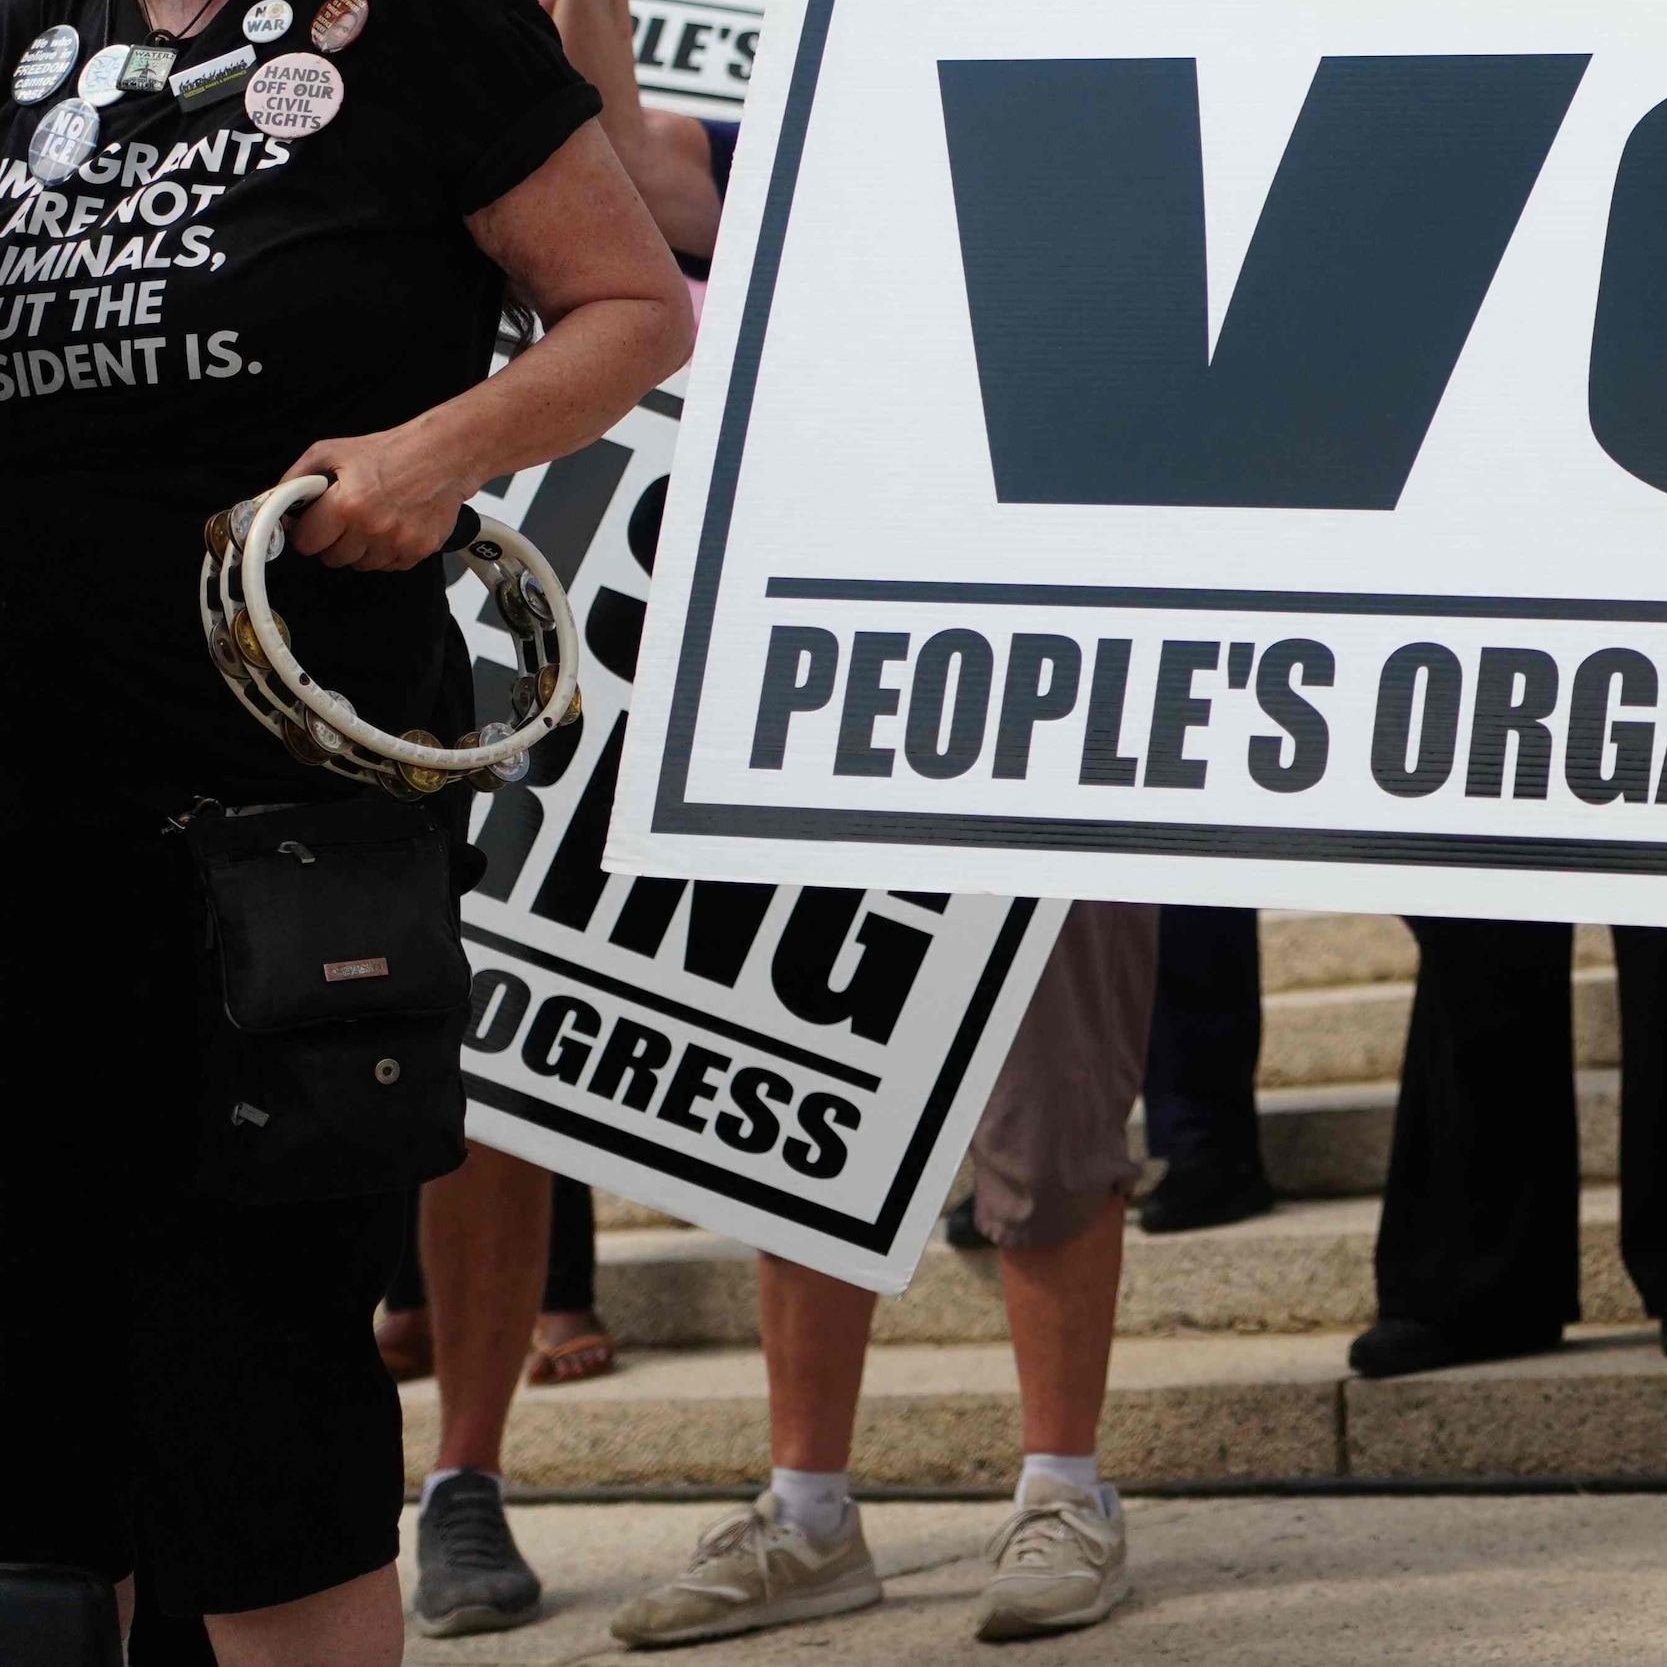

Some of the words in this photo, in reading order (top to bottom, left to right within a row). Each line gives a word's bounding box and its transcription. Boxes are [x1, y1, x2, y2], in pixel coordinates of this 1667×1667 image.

[247, 18, 285, 33] WAR
[30, 38, 49, 50] We
[50, 36, 73, 48] who
[20, 50, 58, 63] believe
[60, 49, 73, 59] in
[13, 61, 71, 77] FREEDOM
[264, 66, 331, 83] HANDS
[15, 74, 58, 89] cannot
[253, 80, 287, 94] OFF
[294, 84, 334, 99] OUR
[16, 90, 46, 101] rest
[266, 97, 313, 113] CIVIL
[52, 110, 84, 138] NO
[251, 111, 322, 130] RIGHTS
[40, 134, 76, 160] ICE
[100, 181, 226, 228] NOT
[0, 191, 104, 238] ARE
[69, 280, 167, 331] THE
[185, 330, 263, 380] IS.
[749, 625, 1334, 793] PEOPLE'S
